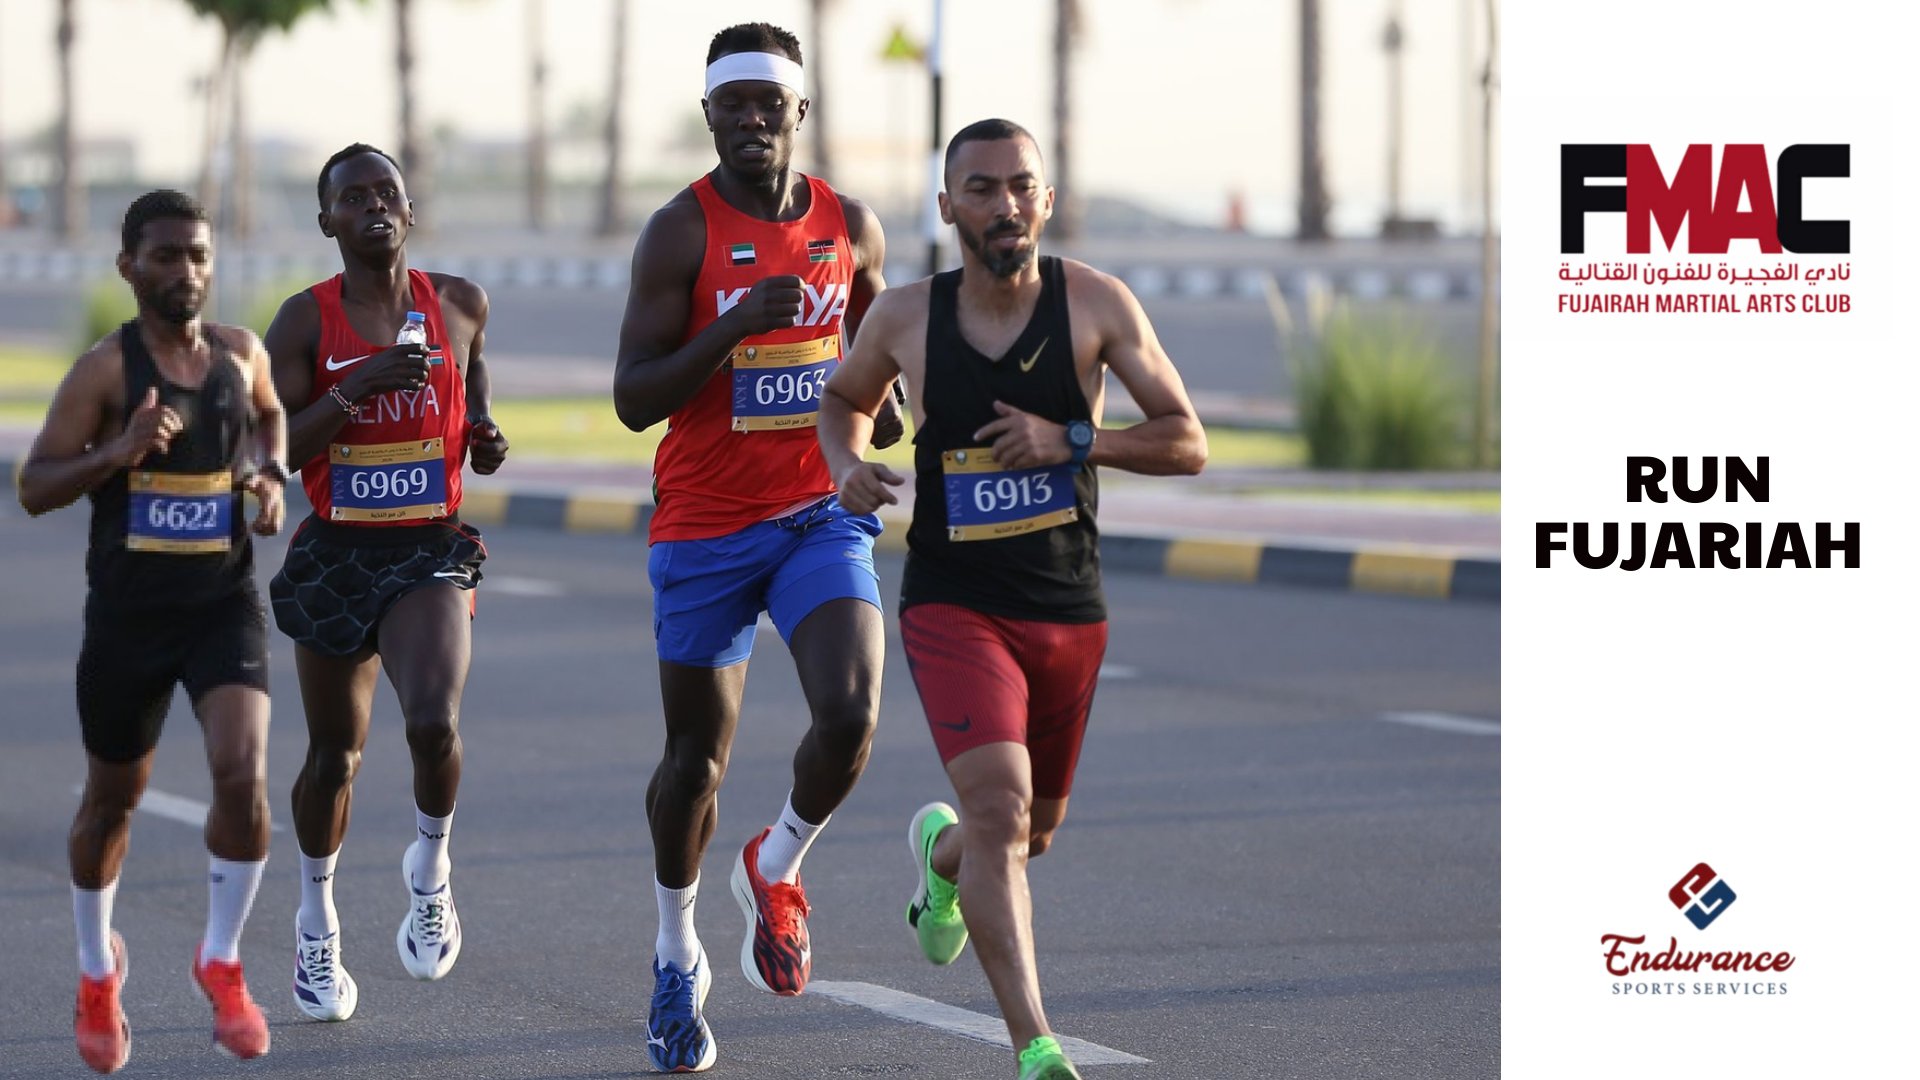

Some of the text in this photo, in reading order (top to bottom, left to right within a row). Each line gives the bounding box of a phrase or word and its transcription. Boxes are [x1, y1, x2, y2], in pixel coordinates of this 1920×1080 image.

[755, 367, 826, 405] 6963
[351, 467, 428, 499] 6969
[974, 472, 1053, 512] 6913
